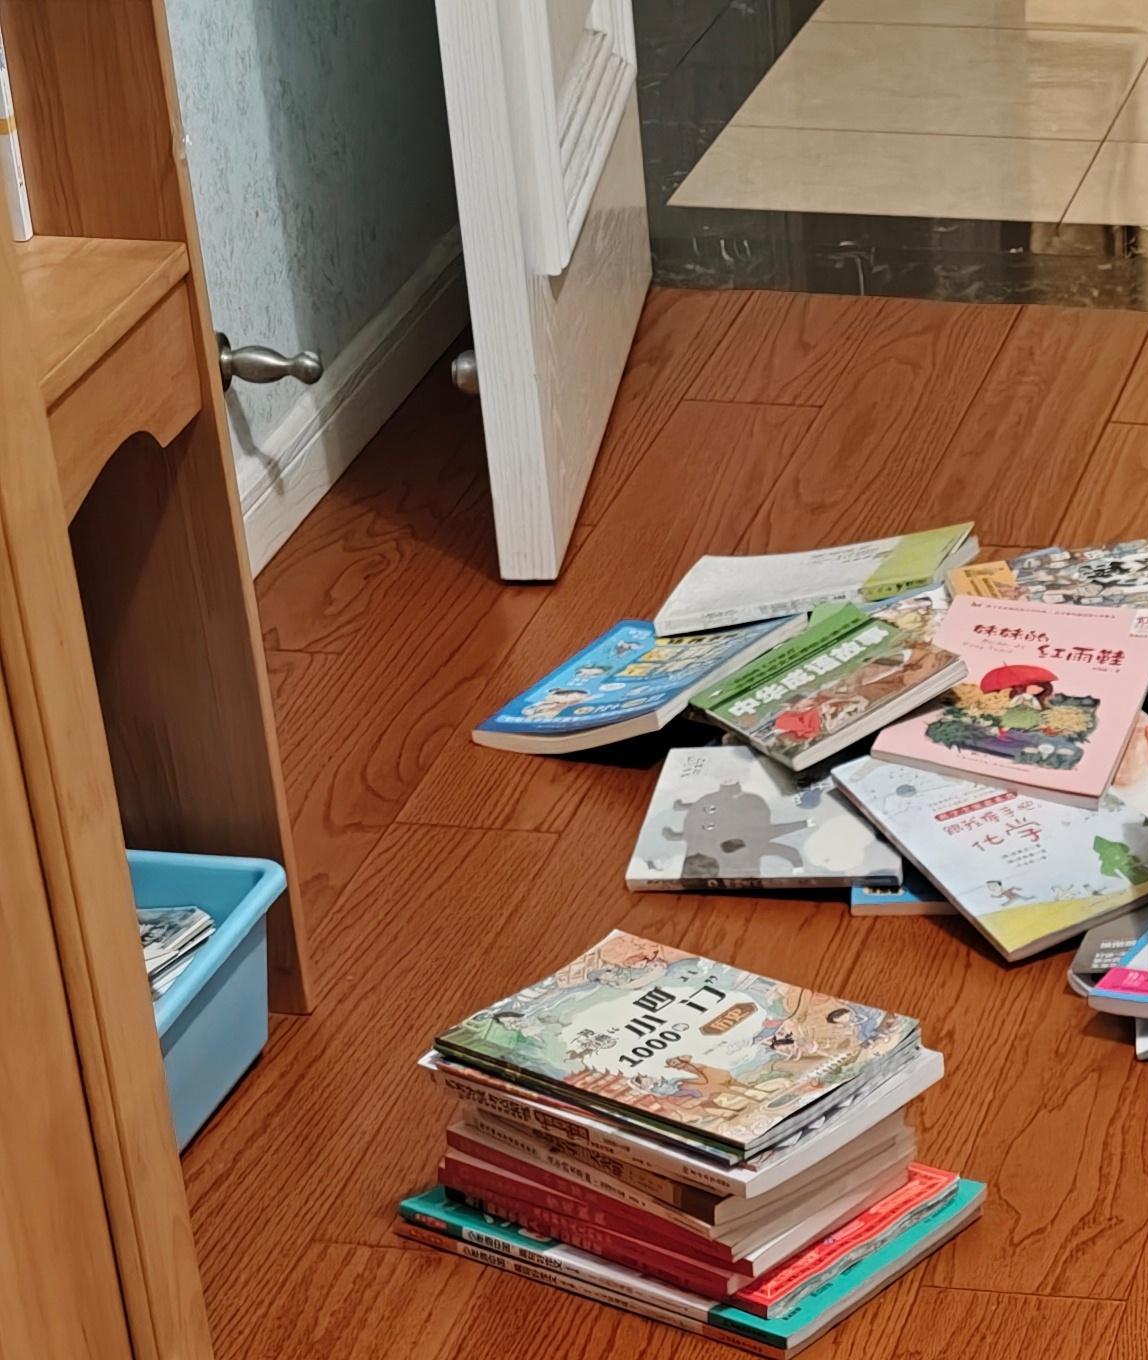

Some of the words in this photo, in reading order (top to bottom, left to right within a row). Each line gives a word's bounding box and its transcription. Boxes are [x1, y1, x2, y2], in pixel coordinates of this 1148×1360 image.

[973, 623, 1051, 645] 妹妹的
[1037, 644, 1126, 667] 红雨鞋
[727, 626, 890, 718] 中华成语故事
[971, 816, 1043, 852] 化学
